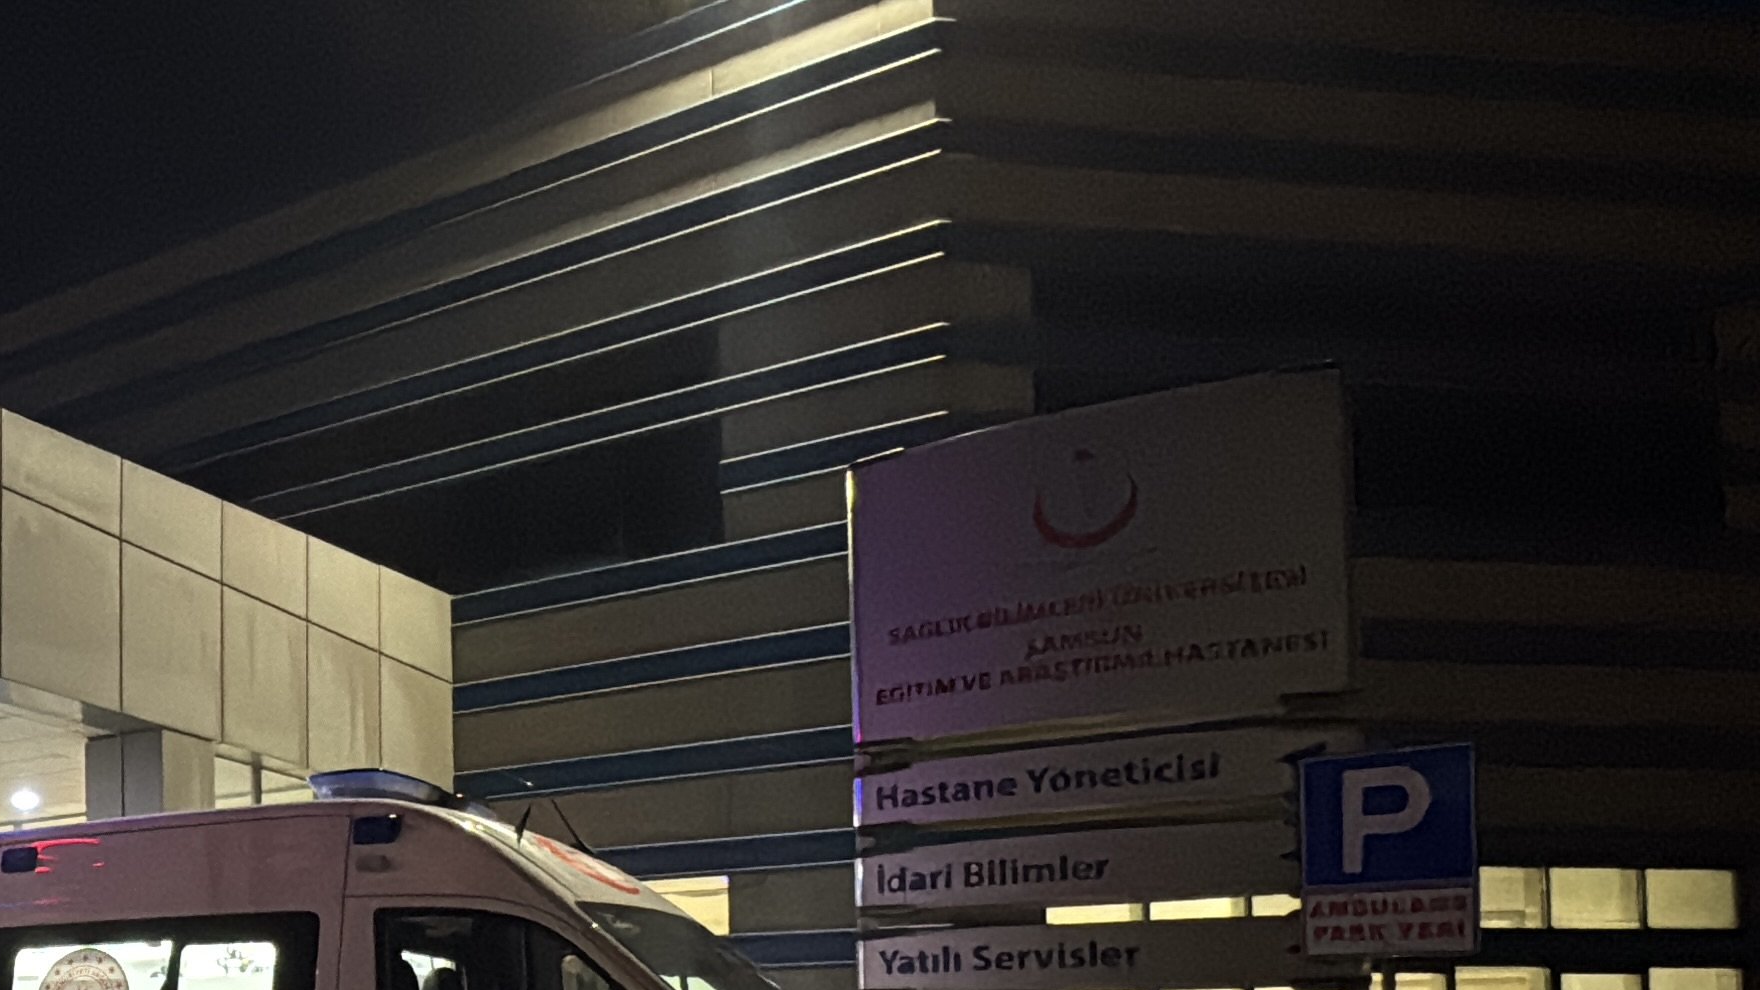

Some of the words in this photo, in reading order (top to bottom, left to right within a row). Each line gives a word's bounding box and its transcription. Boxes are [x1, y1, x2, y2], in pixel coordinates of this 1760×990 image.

[875, 775, 1018, 811] Hastane
[1341, 765, 1433, 875] P
[878, 945, 962, 976] Yatılı
[972, 940, 1141, 973] Servisler
